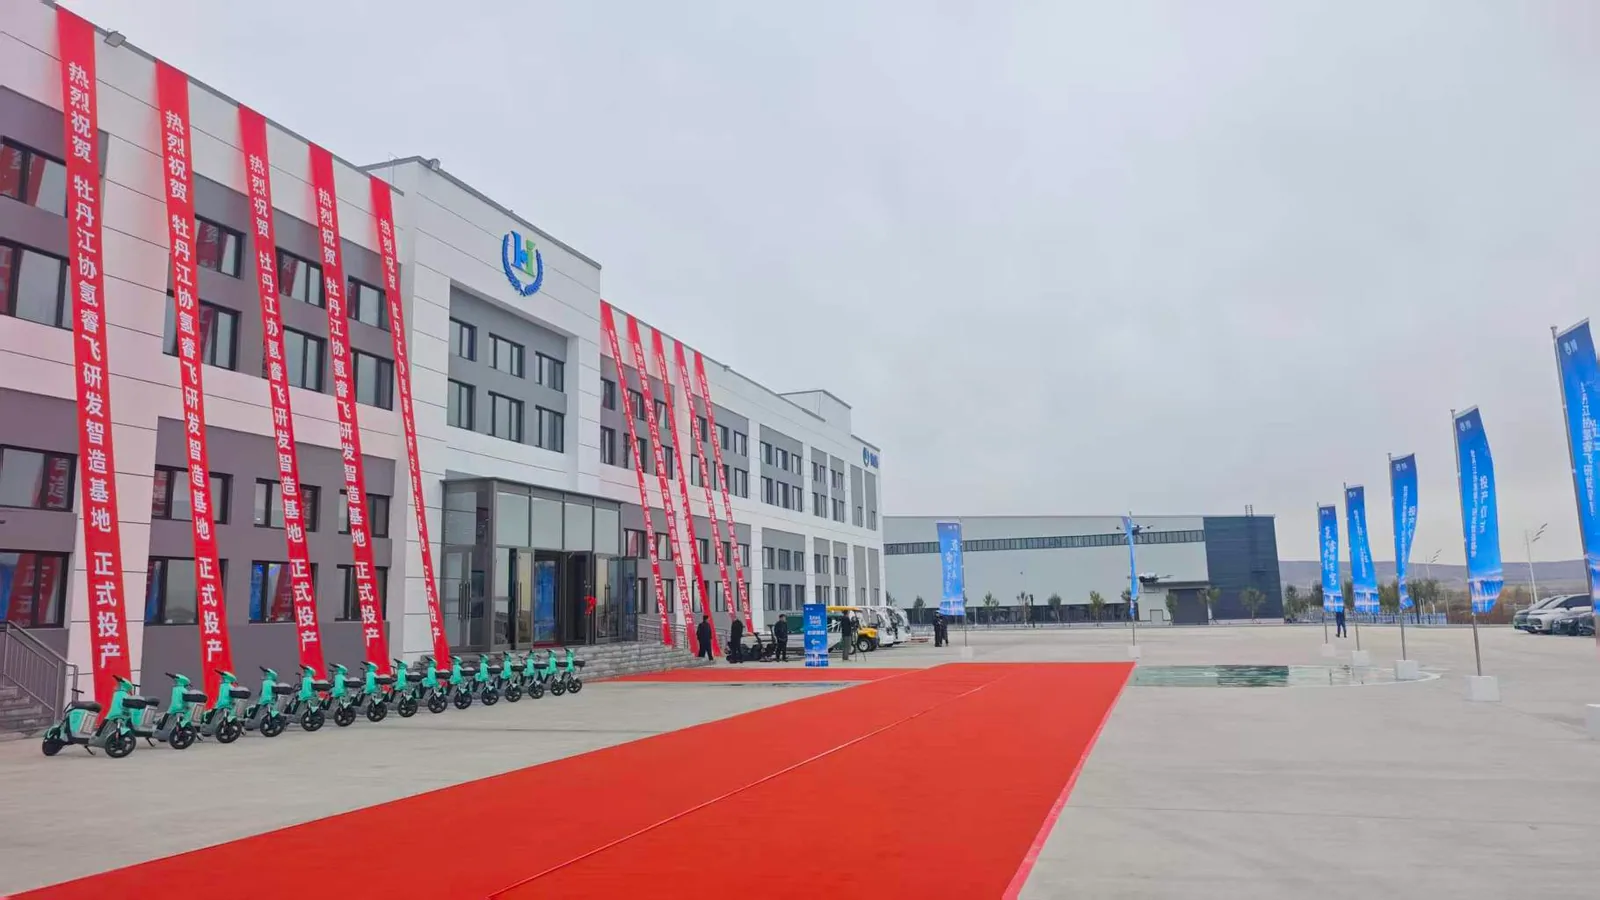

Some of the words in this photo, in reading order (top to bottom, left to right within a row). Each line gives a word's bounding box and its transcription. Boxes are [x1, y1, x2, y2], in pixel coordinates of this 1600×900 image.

[68, 61, 92, 163] 热烈祝贺
[165, 110, 188, 203] 热烈祝贺
[73, 175, 111, 533] 牡丹江协氢睿飞研发智造基地
[171, 214, 209, 540] 牡丹江协氢睿飞研发智造基地
[249, 153, 269, 239] 热烈祝贺
[290, 558, 317, 651] 正式投产
[318, 187, 337, 267] 热烈祝贺
[355, 561, 380, 647] 正式投产
[94, 551, 121, 669] 正式投产
[198, 556, 223, 662] 正式投产
